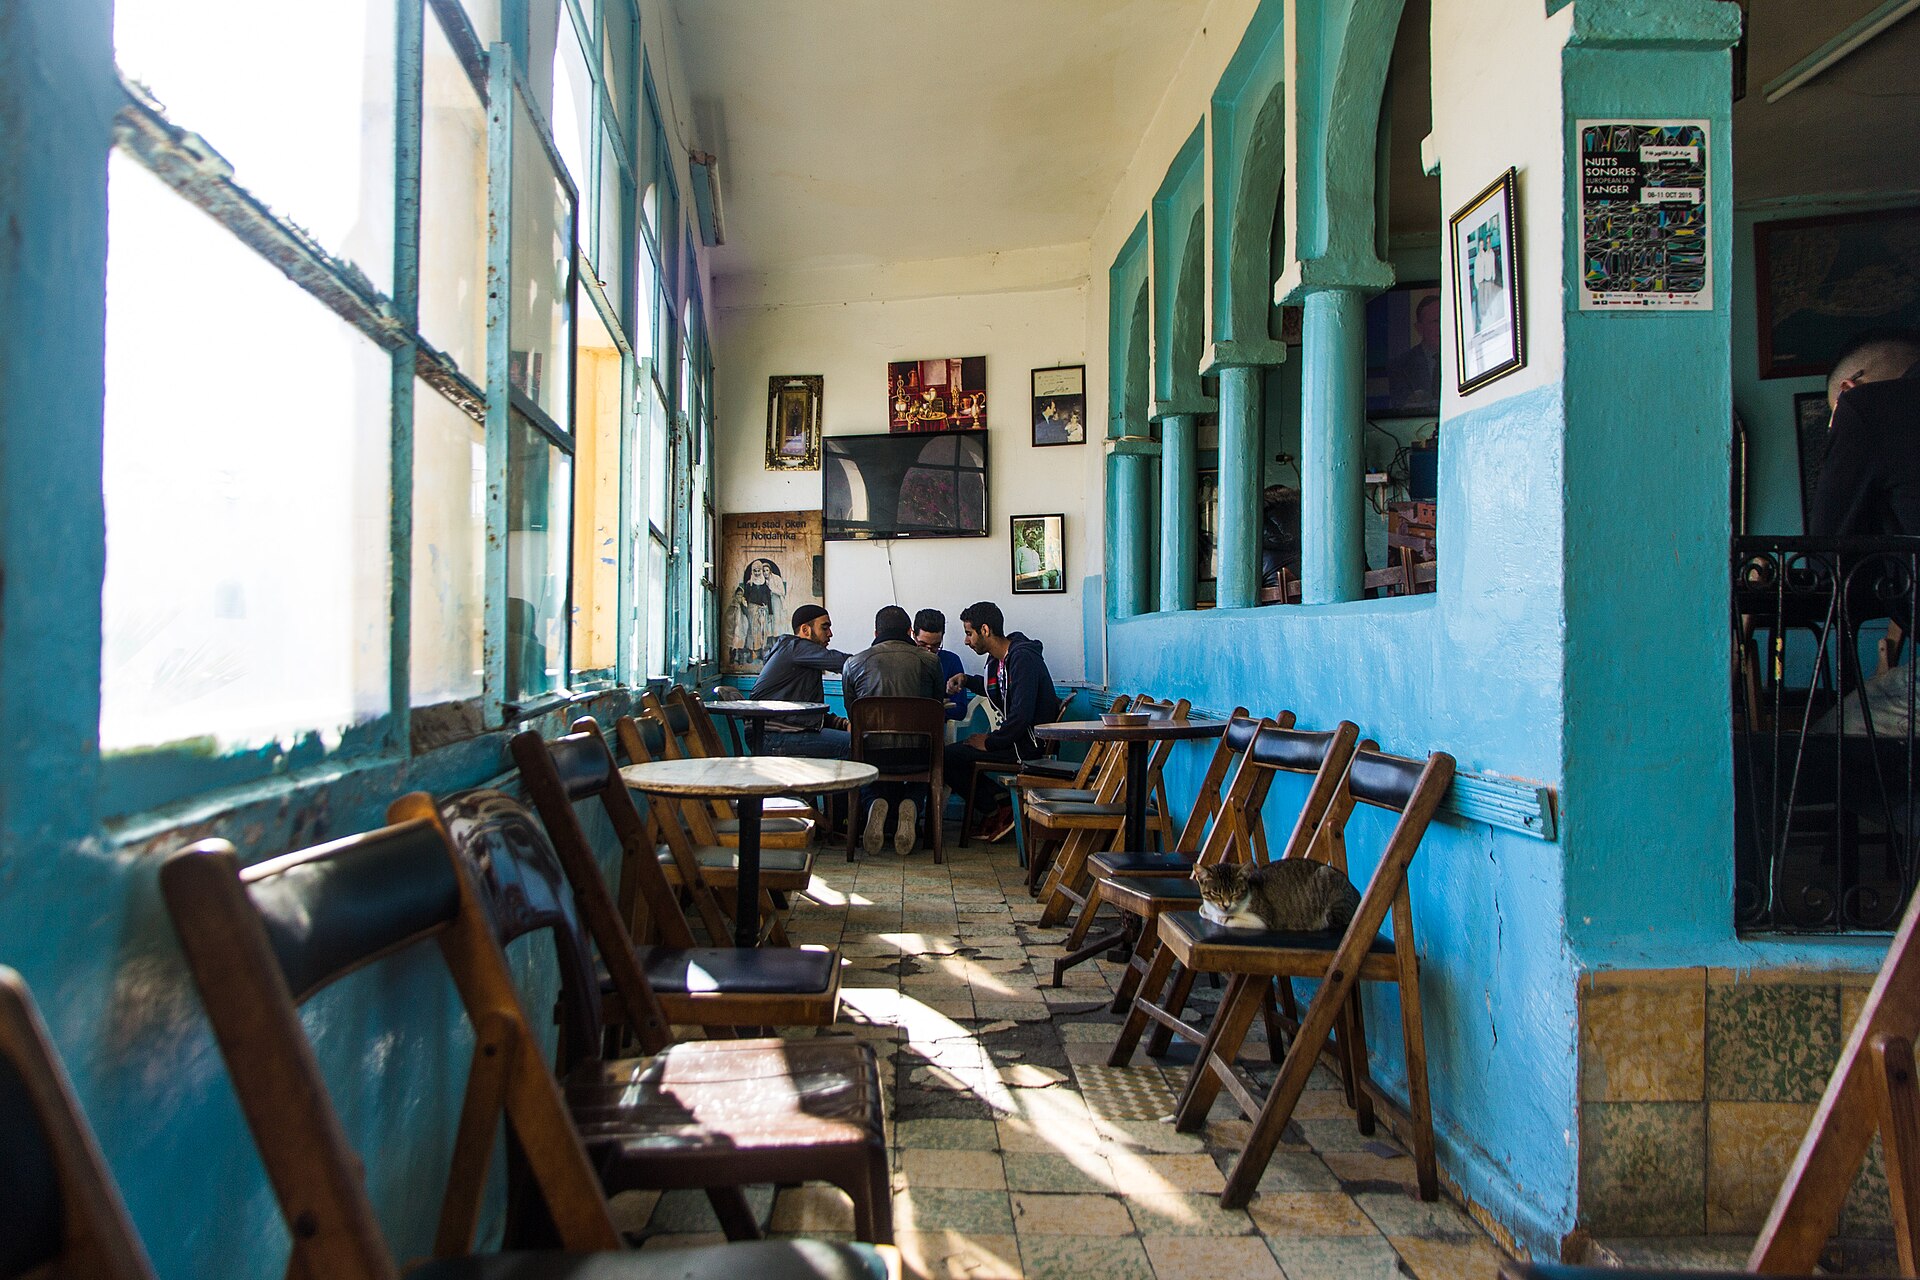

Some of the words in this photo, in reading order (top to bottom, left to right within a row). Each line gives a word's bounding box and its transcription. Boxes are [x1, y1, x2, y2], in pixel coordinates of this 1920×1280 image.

[1585, 157, 1618, 166] NUITS
[1585, 167, 1637, 176] SONORES
[1585, 185, 1629, 194] TANGER
[751, 531, 796, 540] Nordafrika
